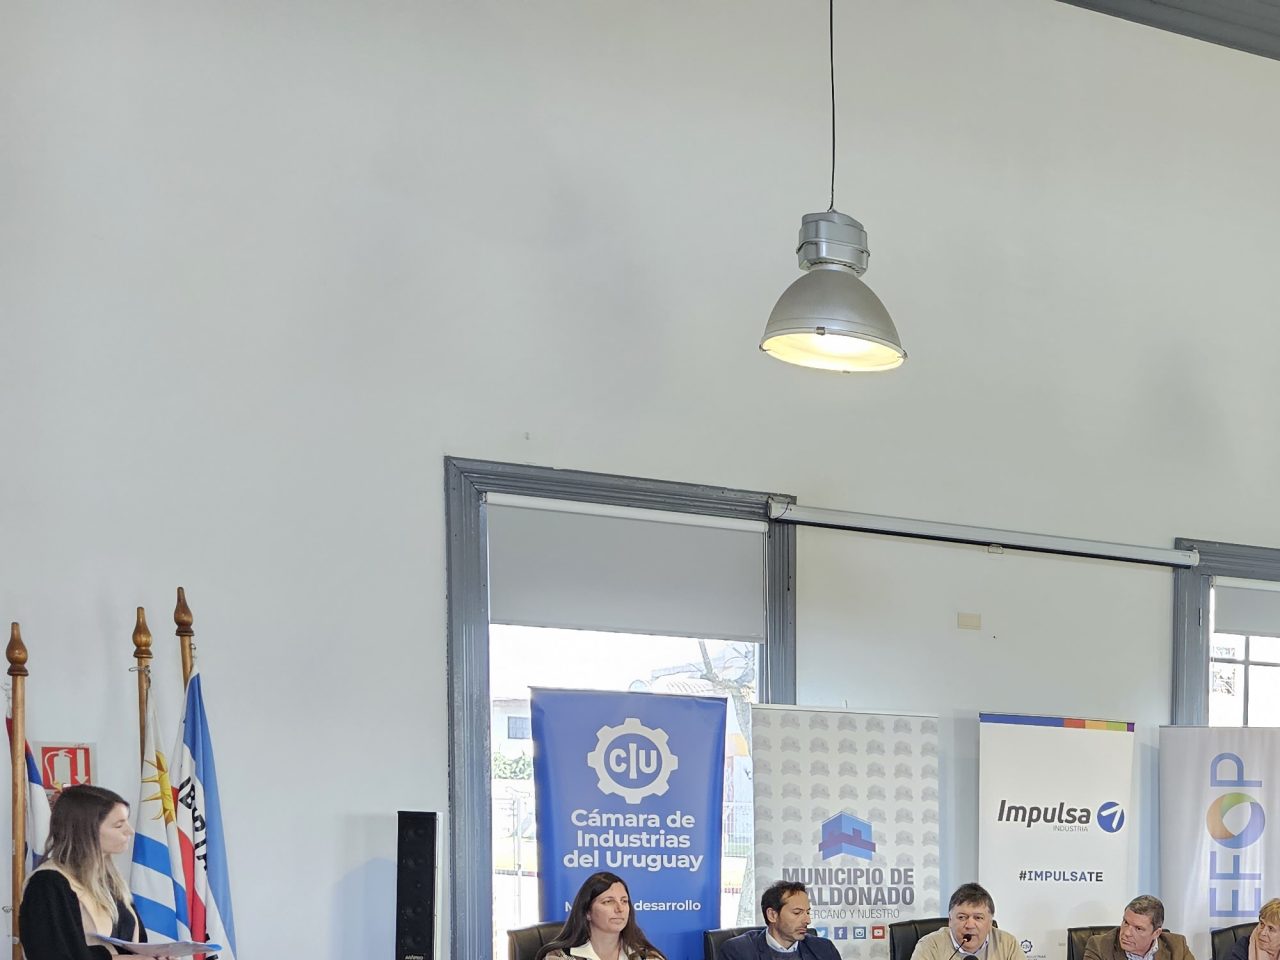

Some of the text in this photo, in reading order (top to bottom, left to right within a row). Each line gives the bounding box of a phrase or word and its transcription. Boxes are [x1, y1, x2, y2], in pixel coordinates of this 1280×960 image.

[609, 743, 657, 779] CIU
[571, 808, 695, 828] Cámara de
[998, 800, 1091, 828] Impulsa
[577, 829, 691, 848] Industrias
[563, 850, 704, 872] del Uruguay
[782, 868, 914, 885] MUNICIPIO DE
[1019, 870, 1103, 882] #IMPULSATE
[634, 900, 701, 911] desarrollo
[807, 886, 915, 906] ALDONADO
[849, 909, 856, 918] Y
[858, 908, 900, 919] NUESTRO
